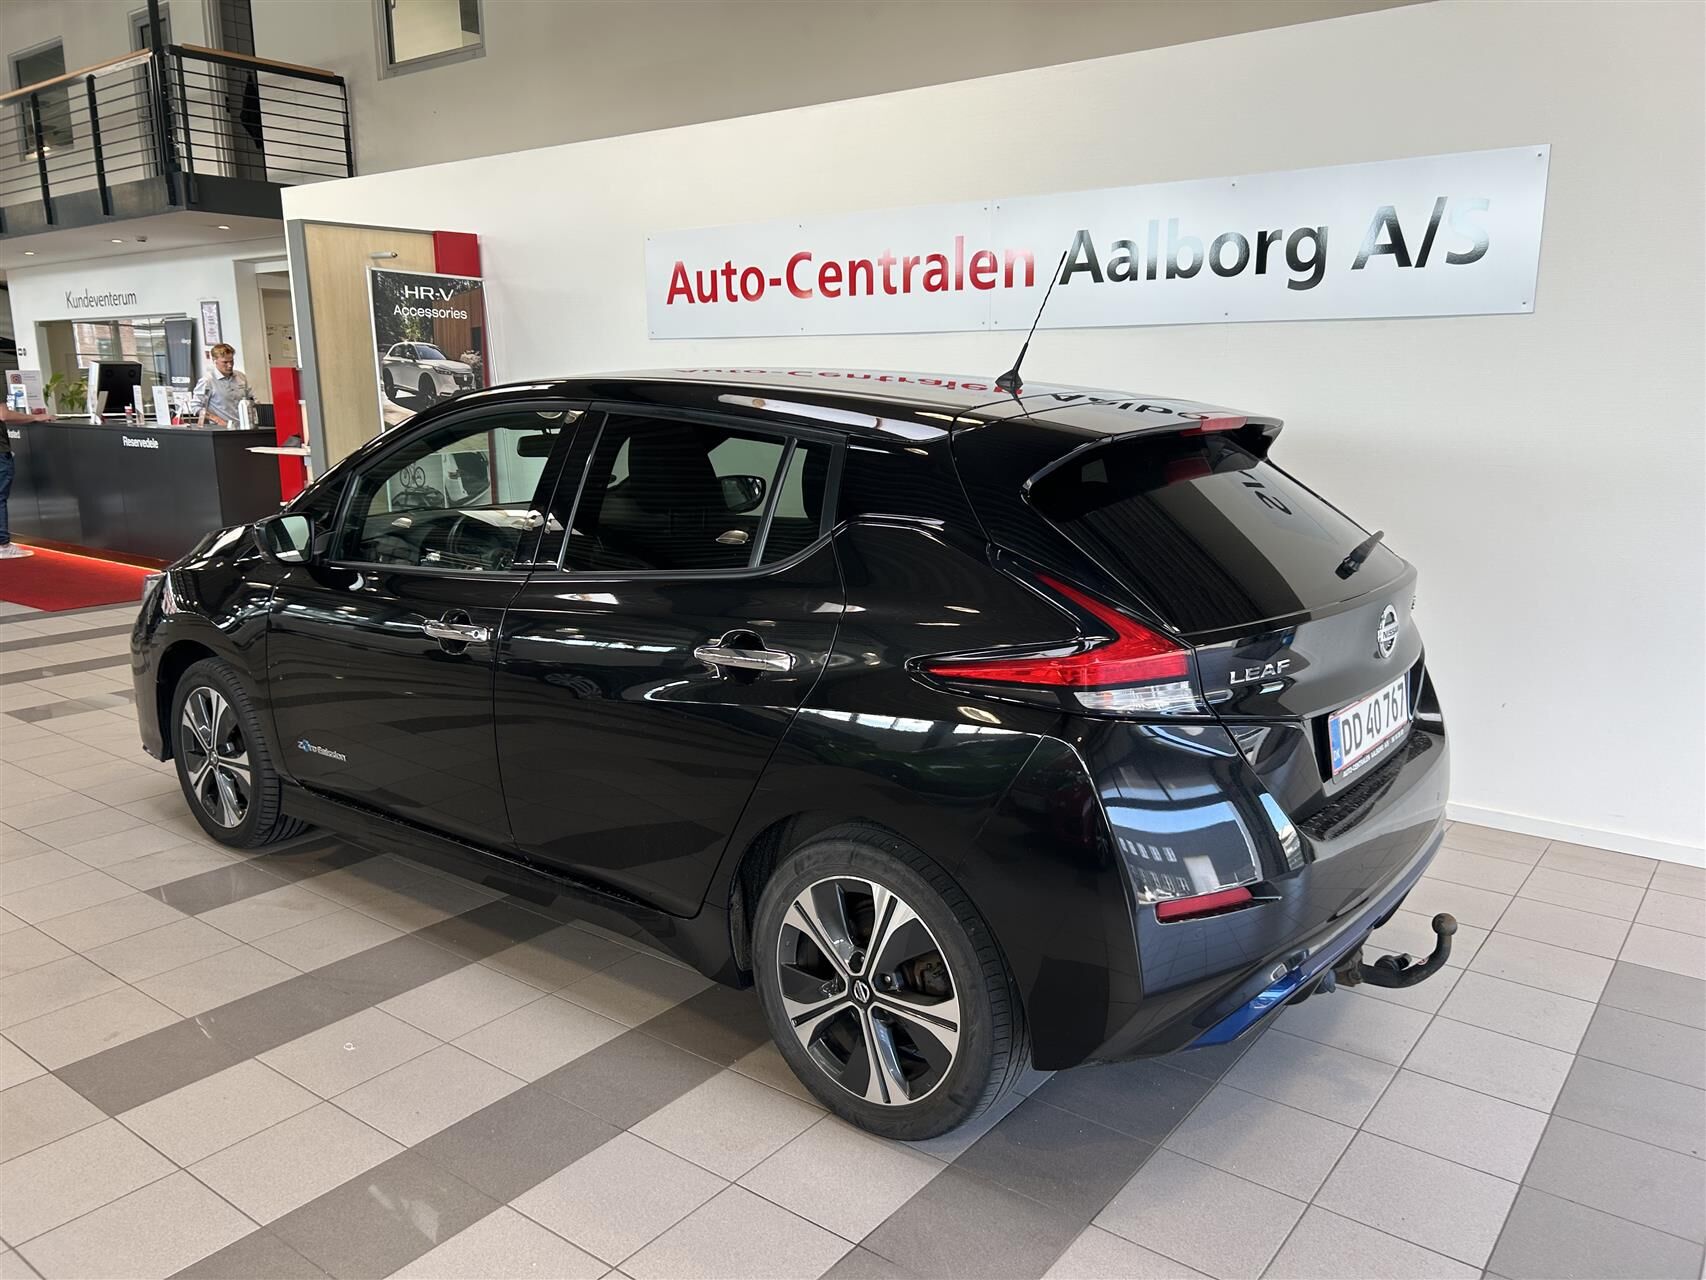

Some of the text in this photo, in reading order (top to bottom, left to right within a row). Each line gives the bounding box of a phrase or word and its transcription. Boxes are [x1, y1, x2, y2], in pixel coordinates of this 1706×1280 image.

[666, 196, 1491, 305] Auto-Centralen Aalborg A/S
[65, 287, 137, 309] Kundeventerum
[403, 285, 454, 301] HR-V
[393, 304, 468, 320] Accessories
[1230, 659, 1290, 684] LEAF
[1342, 712, 1363, 756] DD
[1366, 698, 1381, 739] 40
[1383, 682, 1404, 728] 767
